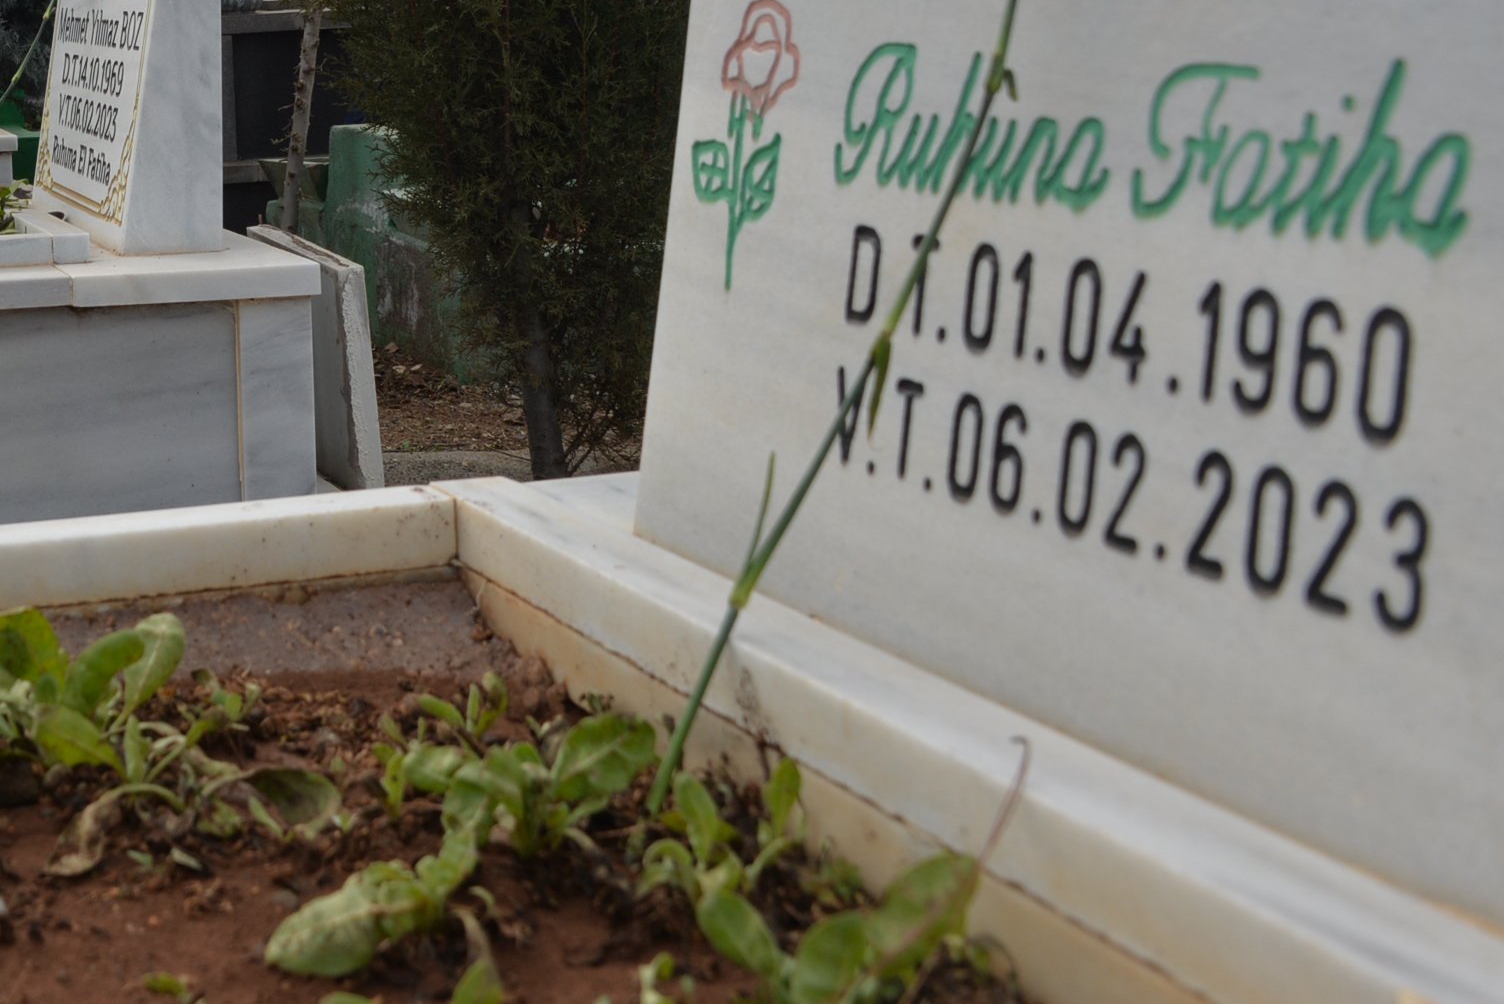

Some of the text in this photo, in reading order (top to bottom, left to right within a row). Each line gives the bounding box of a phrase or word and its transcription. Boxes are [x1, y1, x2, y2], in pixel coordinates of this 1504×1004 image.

[58, 8, 144, 51] Mehmet Yılmaz BOZ
[834, 41, 1470, 258] Ruhuna Fatiha
[843, 224, 1414, 448] DT.01.04.1960
